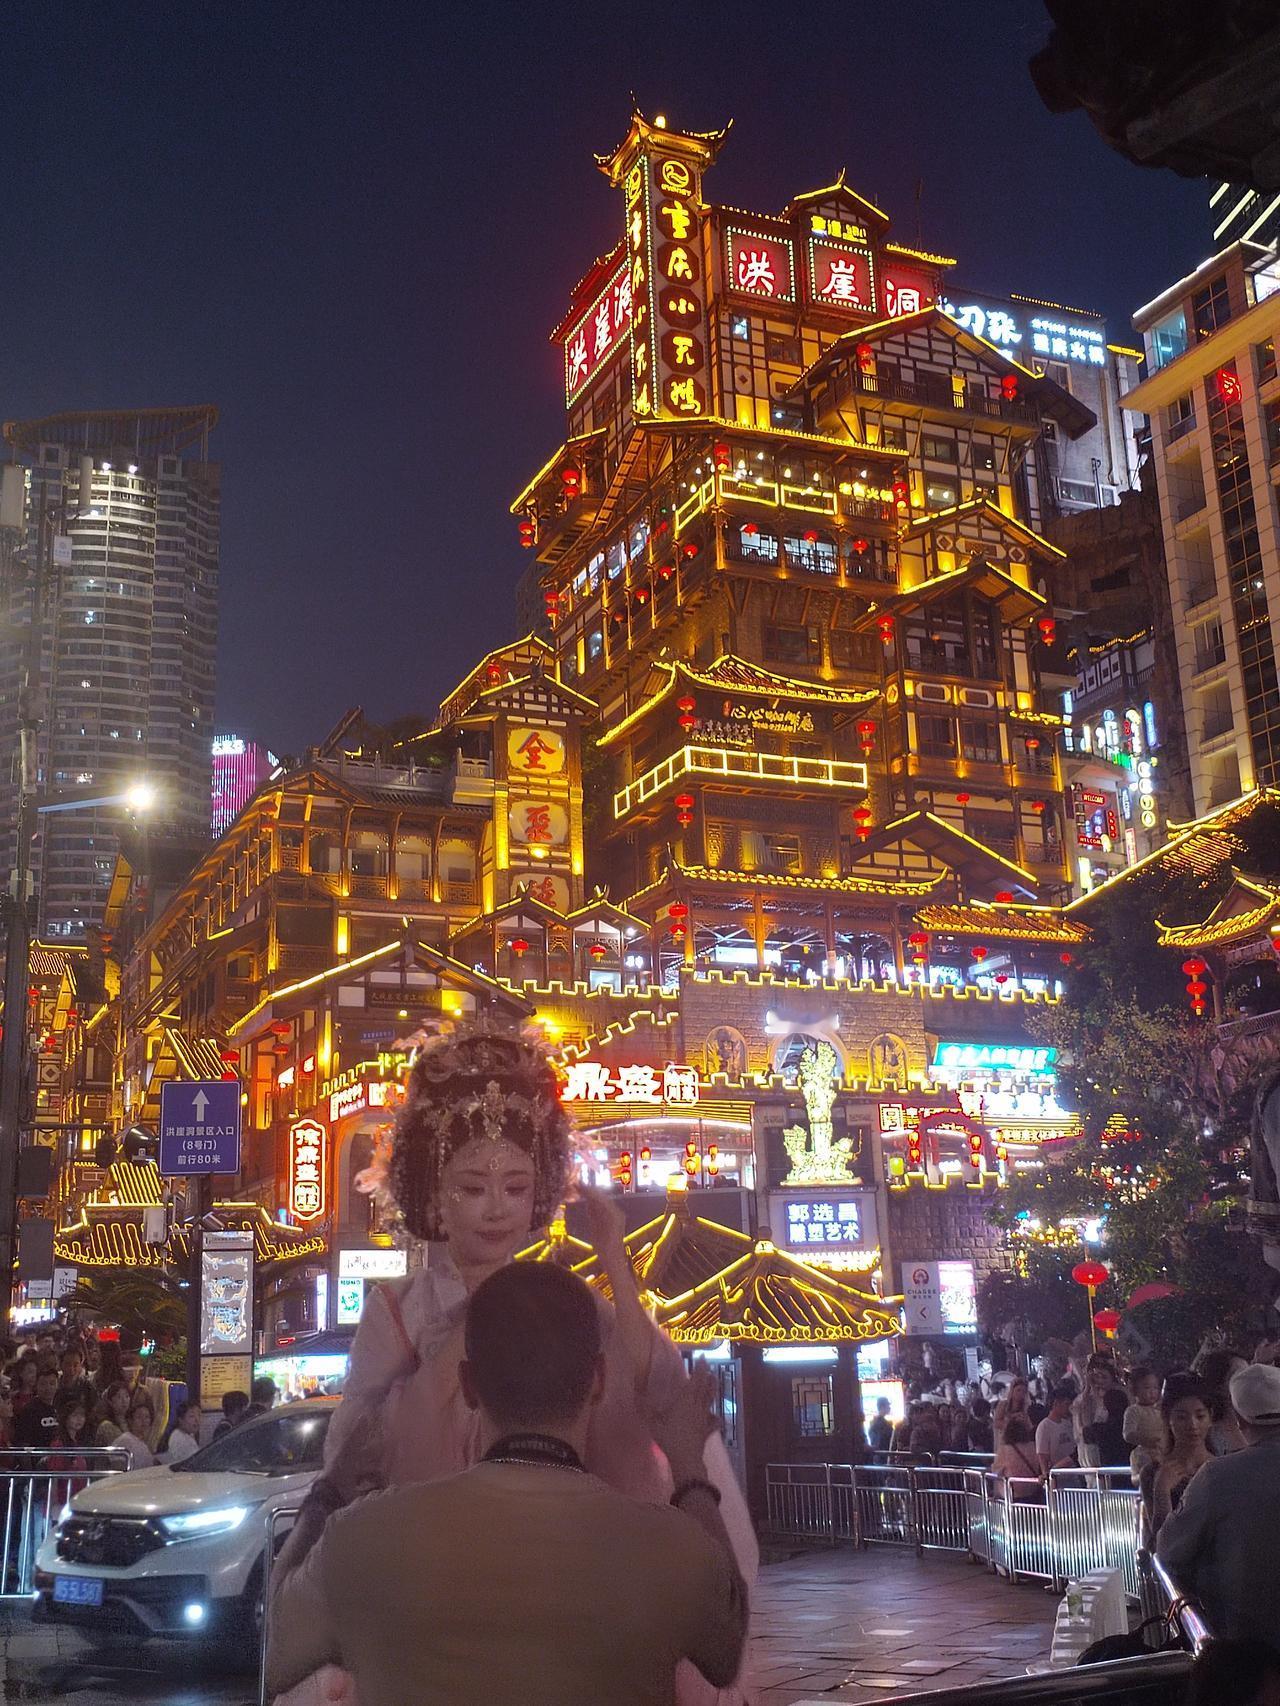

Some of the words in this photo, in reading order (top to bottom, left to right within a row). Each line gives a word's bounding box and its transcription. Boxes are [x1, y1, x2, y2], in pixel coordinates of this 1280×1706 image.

[738, 250, 921, 318] 洪崖洞
[166, 1126, 234, 1137] 洪崖洞景区入口
[182, 1139, 217, 1151] (8号门)
[177, 1154, 221, 1165] 前行80米
[789, 1221, 859, 1243] 雕塑艺术
